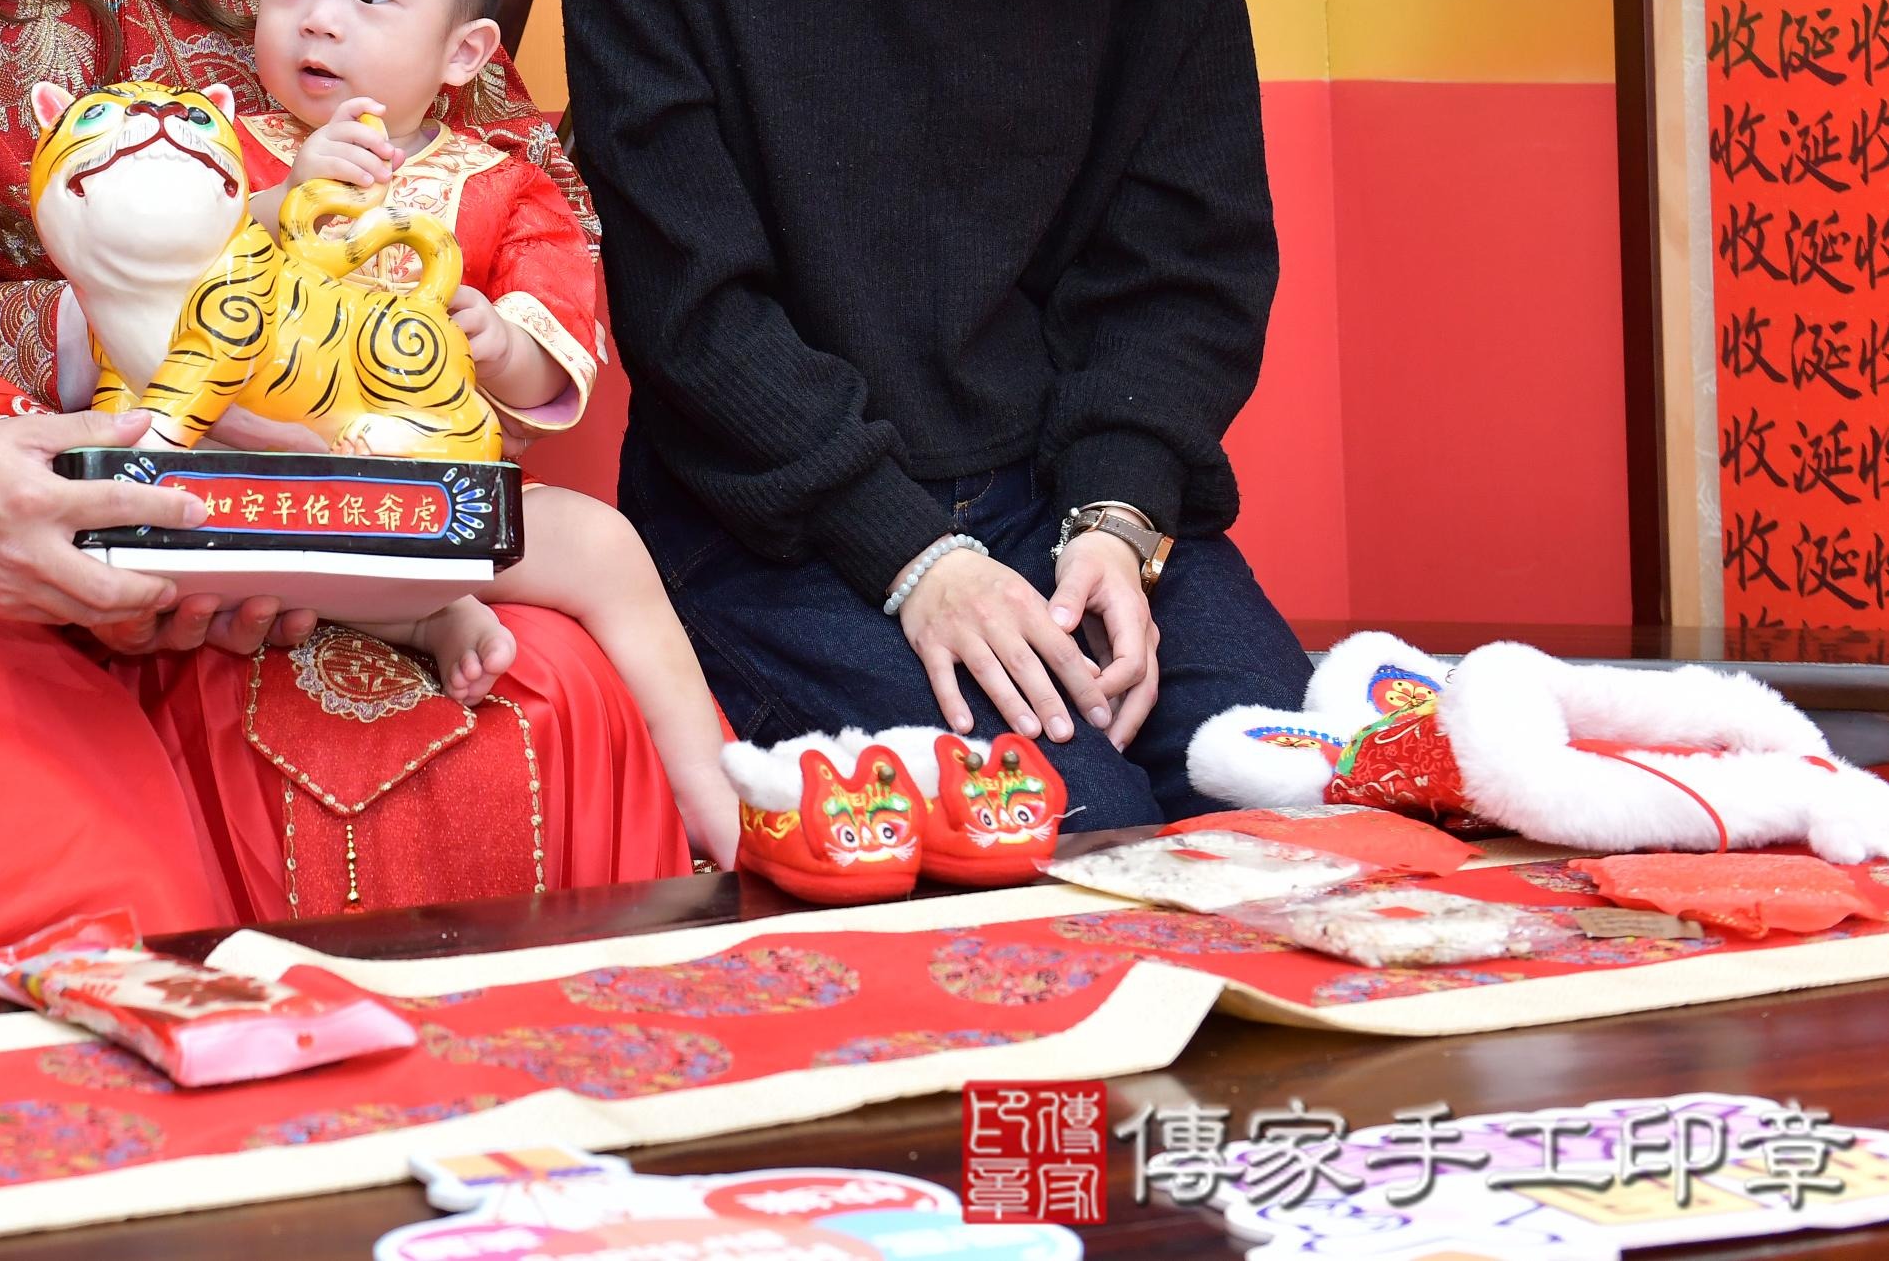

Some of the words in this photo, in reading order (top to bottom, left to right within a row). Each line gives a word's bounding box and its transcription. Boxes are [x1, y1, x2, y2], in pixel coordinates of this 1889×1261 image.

[172, 482, 440, 533] 虎爺保佑平安如
